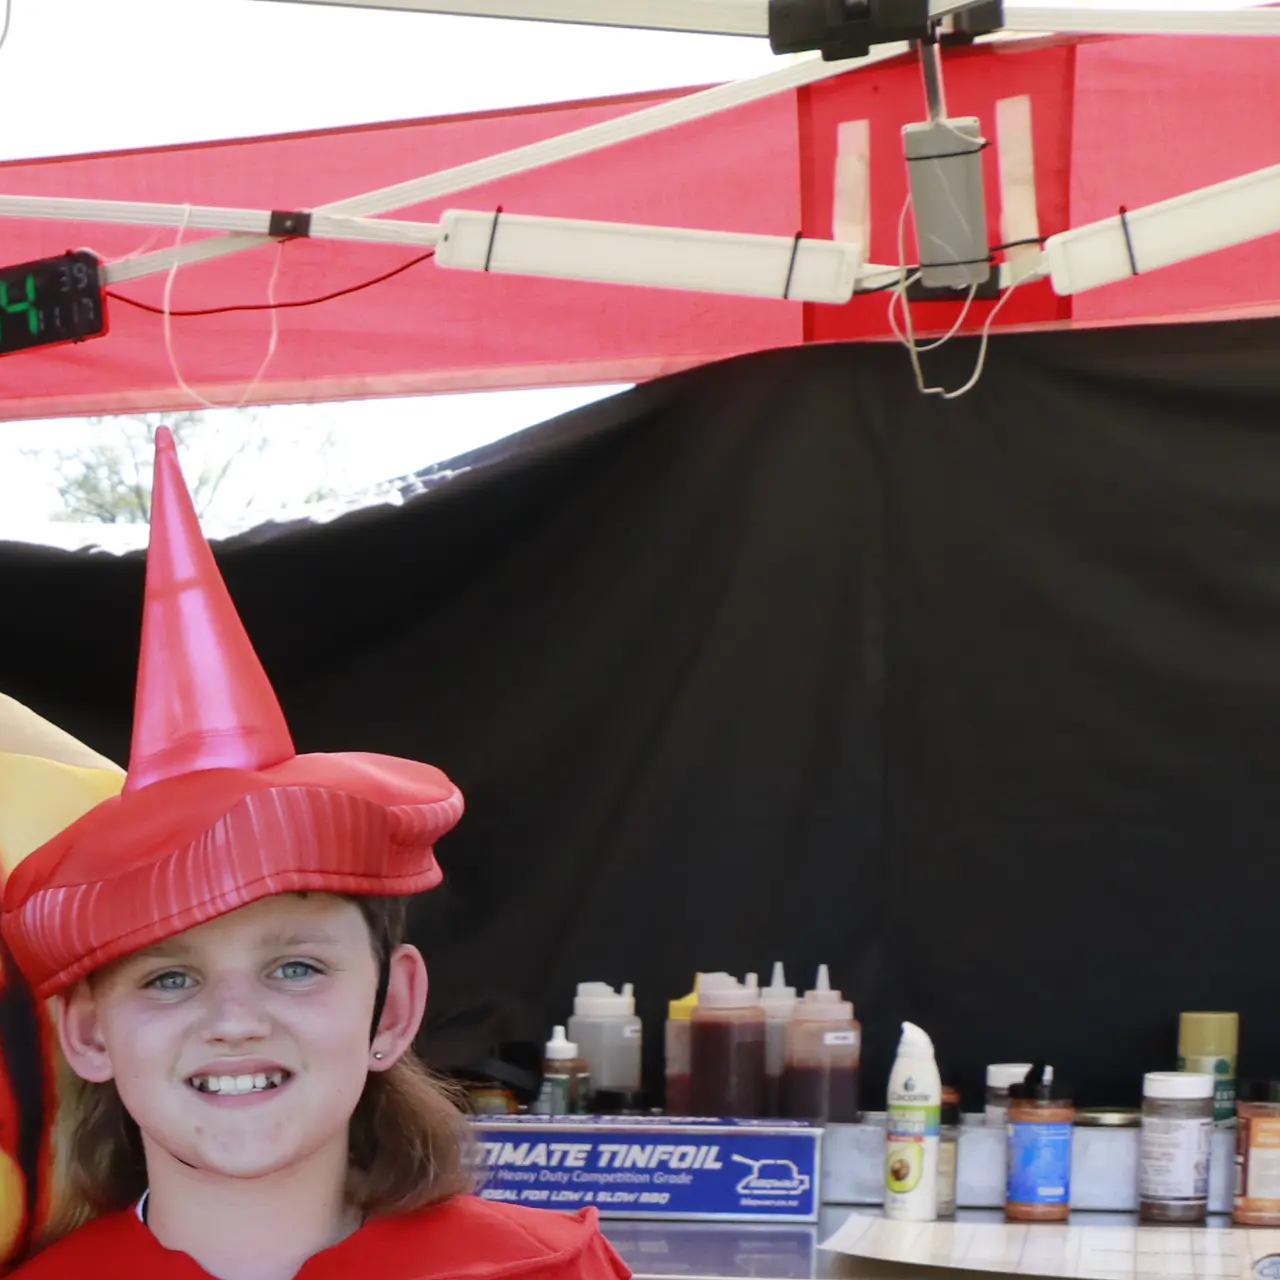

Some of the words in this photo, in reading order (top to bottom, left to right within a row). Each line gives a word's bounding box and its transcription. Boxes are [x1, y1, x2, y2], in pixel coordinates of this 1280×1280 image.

[597, 1143, 723, 1169] TINFOIL
[498, 1170, 538, 1183] Heavy
[540, 1170, 570, 1184] Duty
[572, 1171, 649, 1185] Competition
[653, 1172, 693, 1184] Grade
[520, 1190, 550, 1201] FOR
[550, 1190, 583, 1202] LOW
[596, 1192, 639, 1203] SLOW
